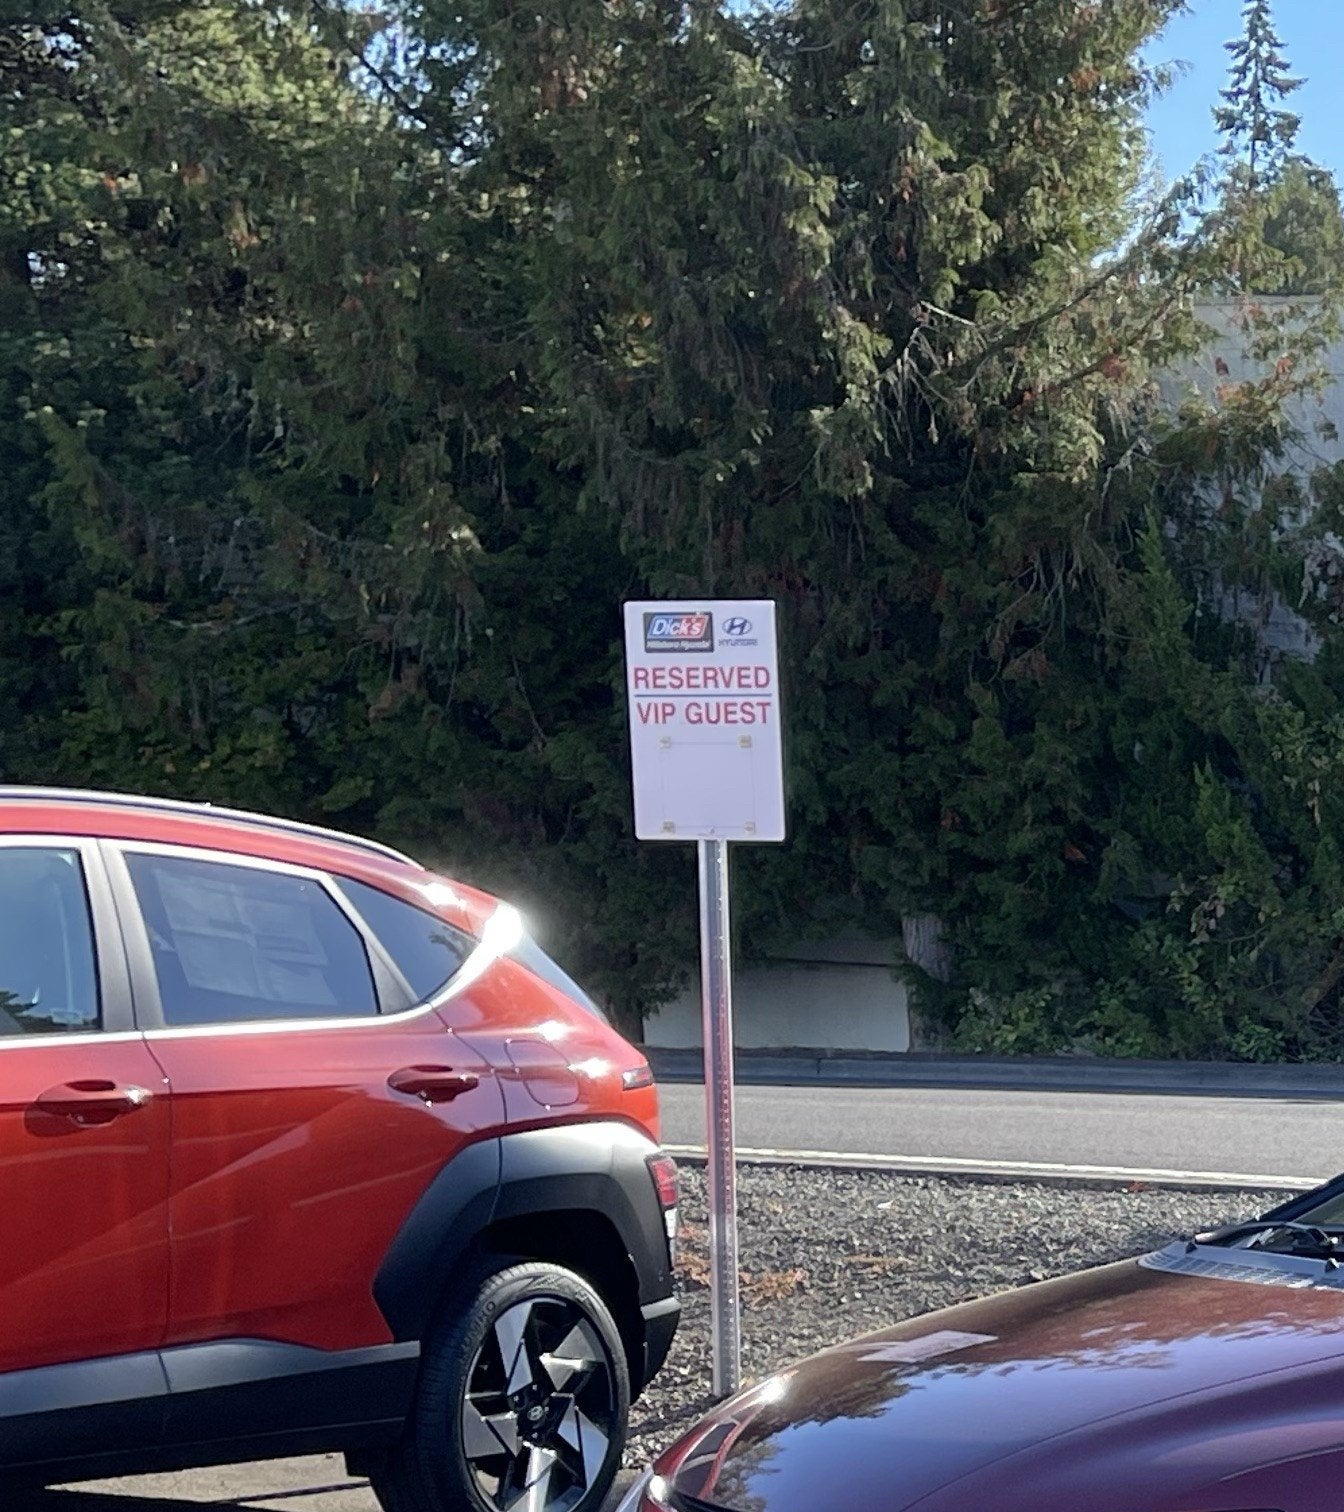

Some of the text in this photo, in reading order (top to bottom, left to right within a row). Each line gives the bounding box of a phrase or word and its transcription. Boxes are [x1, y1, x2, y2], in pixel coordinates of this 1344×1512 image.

[634, 666, 770, 689] RESERVED
[637, 702, 771, 725] VIP GUEST
